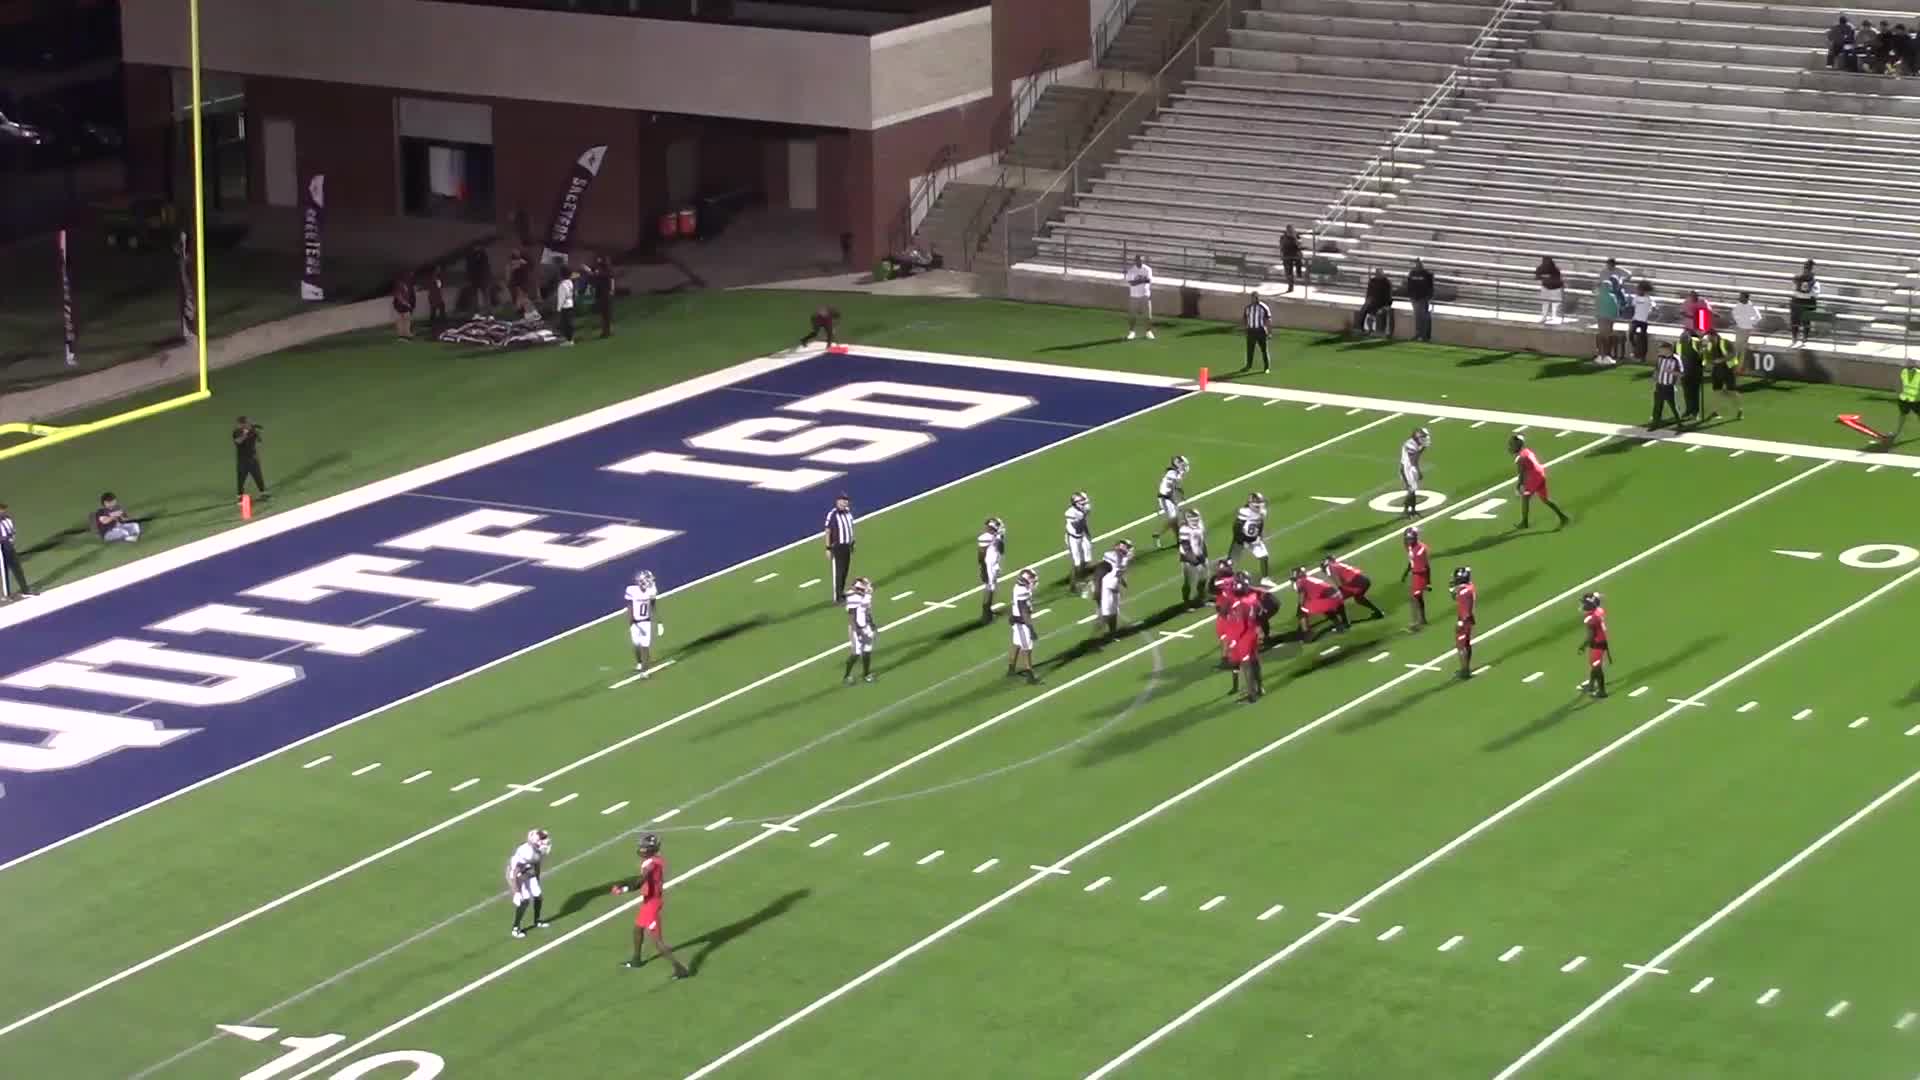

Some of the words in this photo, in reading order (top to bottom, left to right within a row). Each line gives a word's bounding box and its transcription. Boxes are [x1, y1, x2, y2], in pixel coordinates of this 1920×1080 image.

[1753, 353, 1775, 371] 10
[1838, 544, 1920, 568] 0
[0, 509, 686, 772] QUITE
[599, 381, 1038, 492] ISD
[639, 602, 649, 617] 0
